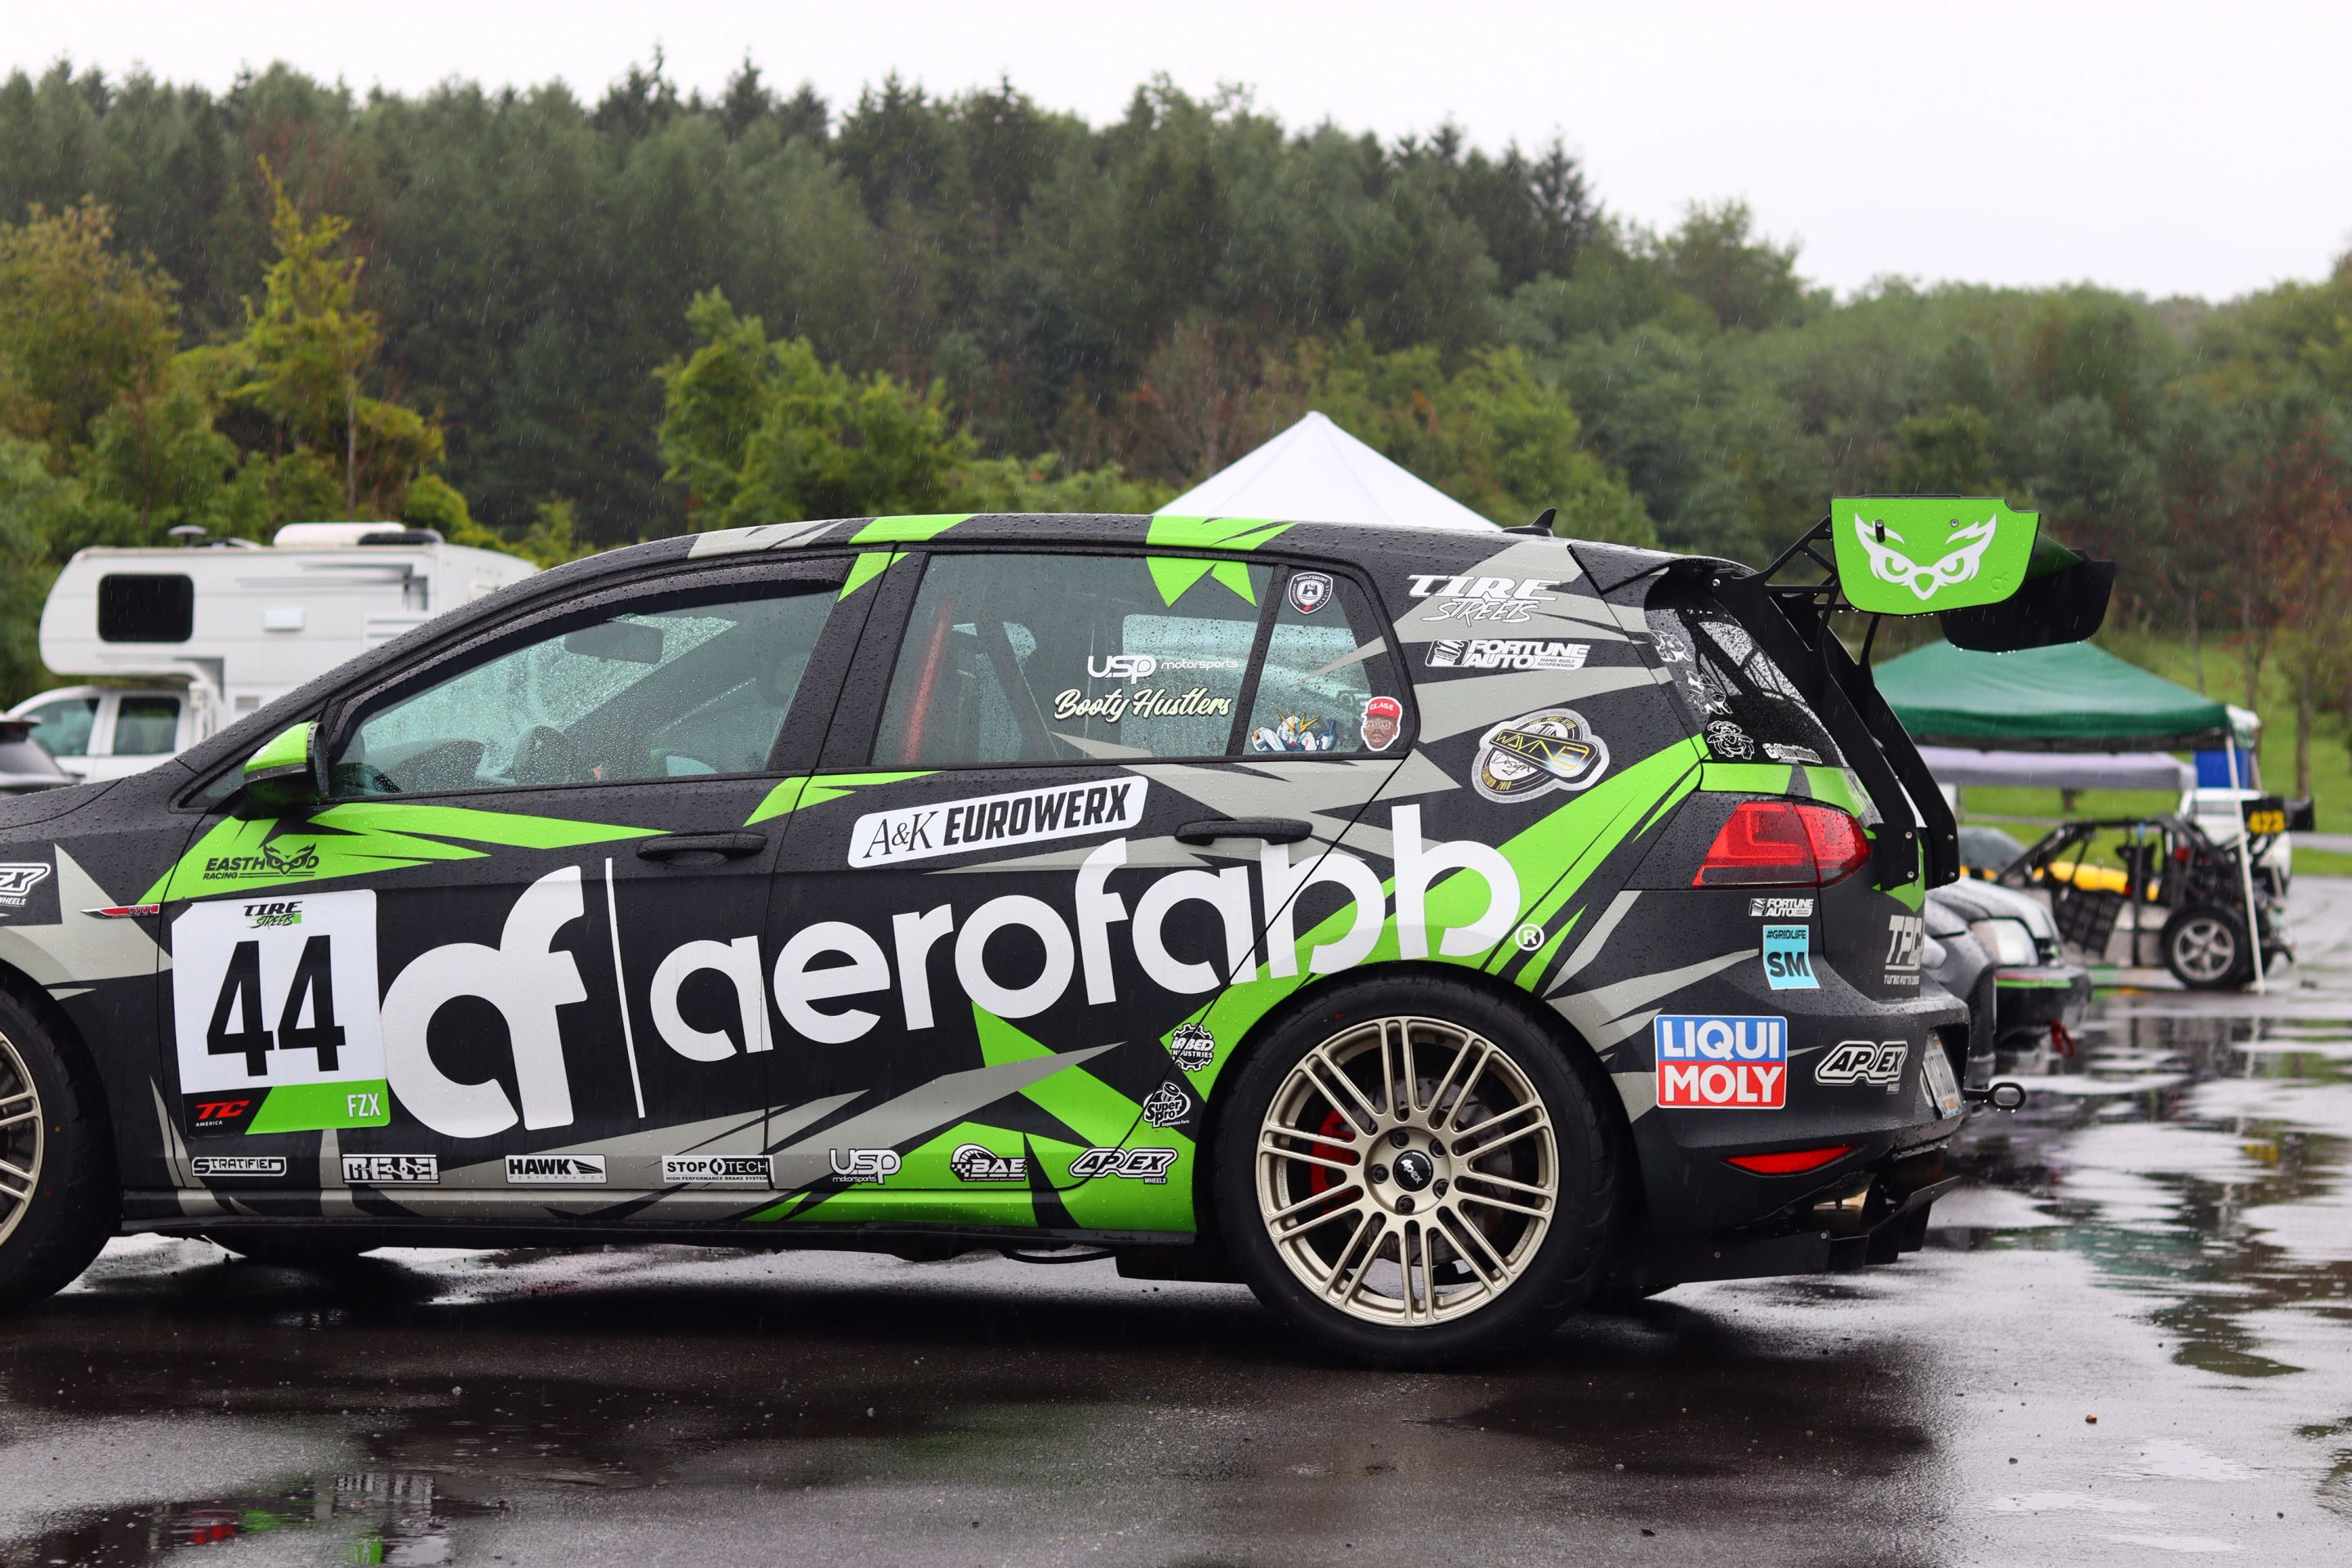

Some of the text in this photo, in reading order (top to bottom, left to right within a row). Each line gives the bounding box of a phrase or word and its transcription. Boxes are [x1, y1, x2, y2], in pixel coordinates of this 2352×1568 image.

[1297, 575, 1329, 583] WOLFSBURG
[1407, 574, 1561, 601] TIRE
[1420, 598, 1541, 627] STREETS
[1470, 639, 1591, 658] FORTUNE
[1087, 655, 1240, 684] USP motorsports
[1463, 653, 1535, 668] AUTO
[1054, 687, 1232, 723] Booty Hustlers
[1495, 730, 1590, 771] WAYNE
[1490, 752, 1532, 773] Design
[862, 782, 1132, 858] A&K EUROWERX
[203, 871, 238, 880] RACING
[243, 902, 303, 916] TIRE
[1766, 898, 1815, 908] FORTUNE
[1766, 906, 1795, 917] AUTO
[251, 914, 295, 929] STREETS
[651, 804, 1521, 1062] aerofabb
[1766, 929, 1806, 940] #GRIDLIFE
[1766, 951, 1811, 978] SM
[207, 934, 345, 1077] 44
[1663, 1020, 1780, 1061] LIQUI
[1825, 1050, 1904, 1073] APEX
[1664, 1064, 1784, 1102] MOLY
[195, 1100, 250, 1120] TC
[346, 1093, 381, 1118] FZX
[194, 1158, 285, 1174] STRATIFIED
[509, 1159, 572, 1174] HAWK
[667, 1160, 768, 1173] STOP TECH
[971, 1158, 1027, 1174] BAE
[833, 1174, 877, 1183] motorsports
